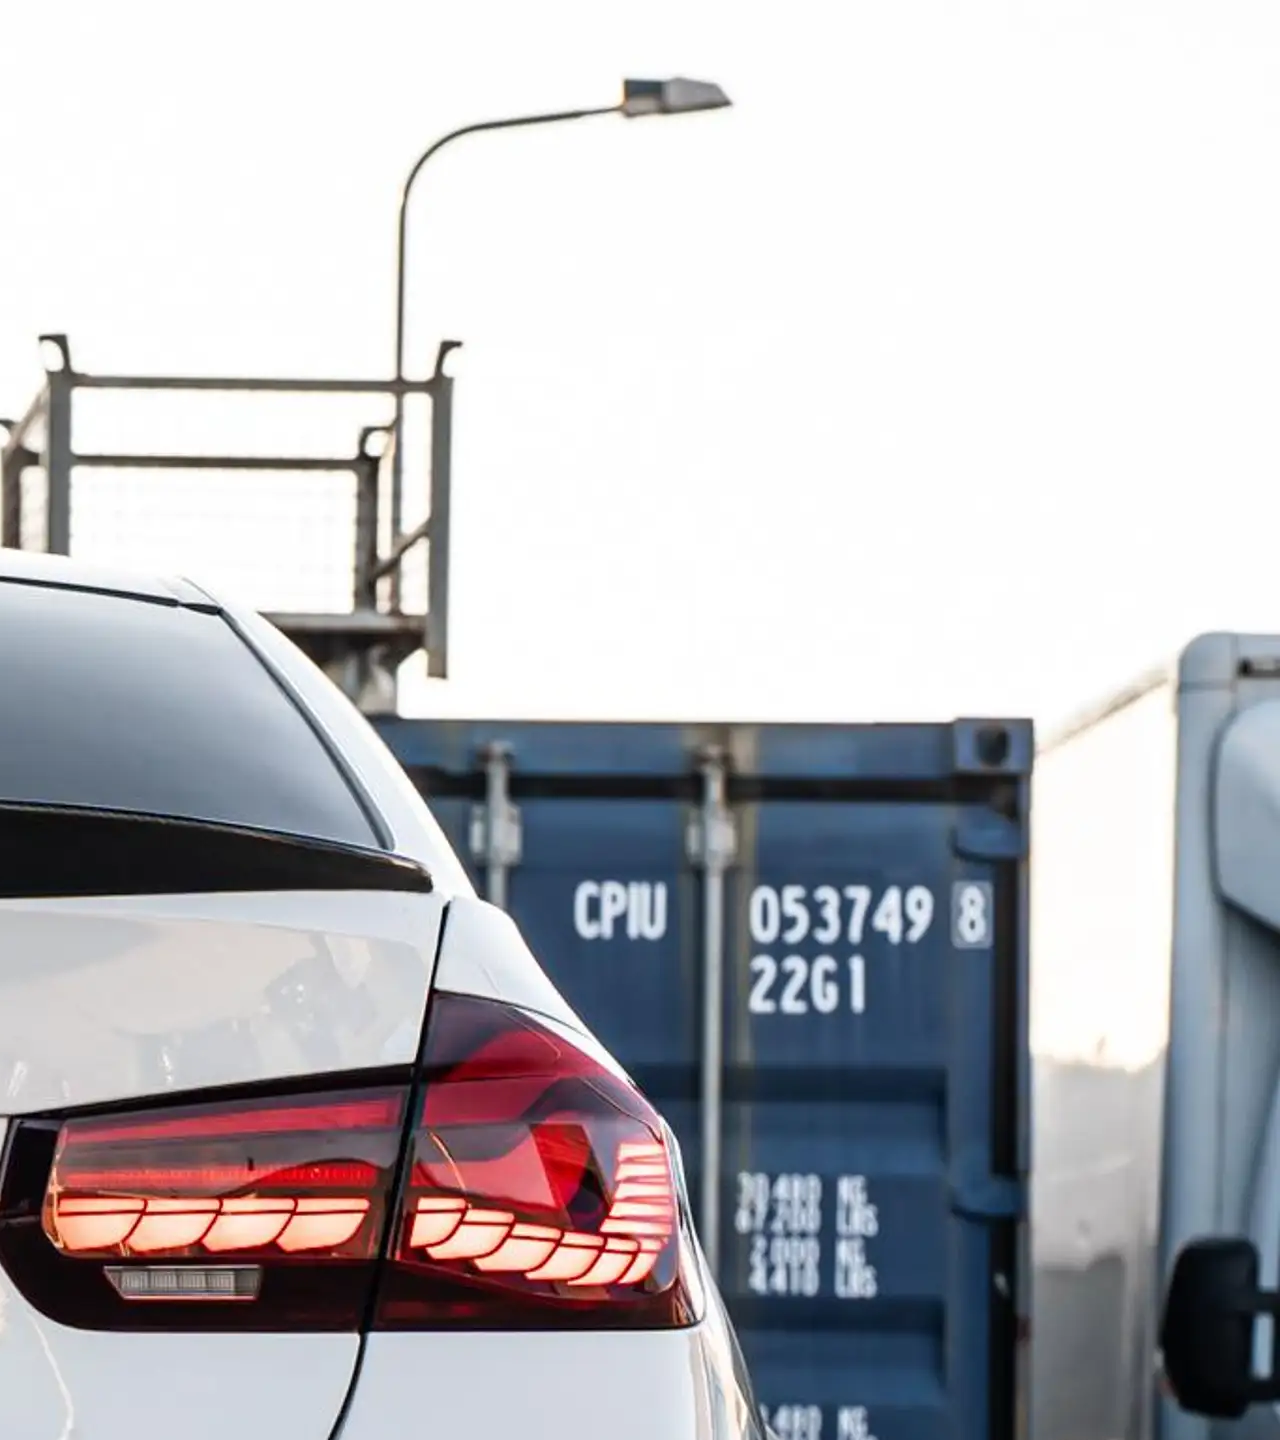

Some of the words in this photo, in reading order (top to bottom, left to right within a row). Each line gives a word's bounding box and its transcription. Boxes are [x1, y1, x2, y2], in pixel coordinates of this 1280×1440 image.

[574, 880, 668, 941] CPIU
[749, 885, 934, 945] 053749
[957, 886, 988, 943] 8
[748, 954, 866, 1014] 22G1
